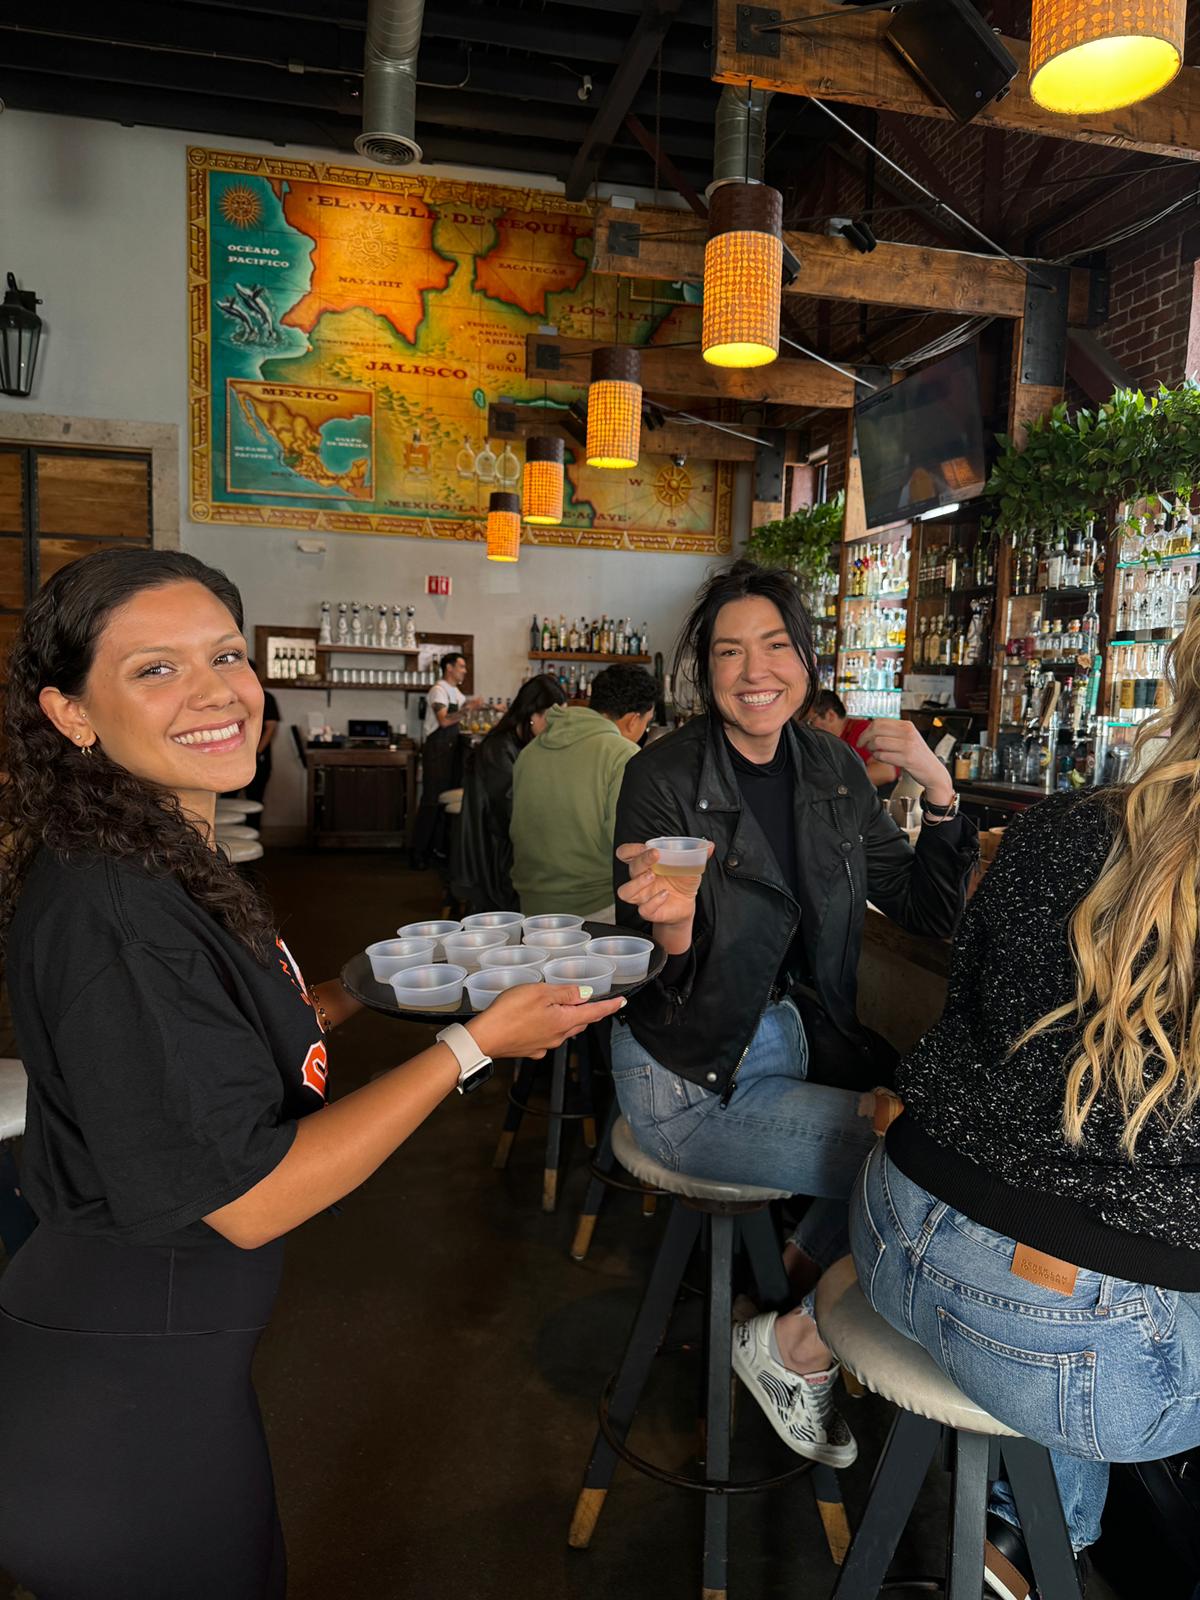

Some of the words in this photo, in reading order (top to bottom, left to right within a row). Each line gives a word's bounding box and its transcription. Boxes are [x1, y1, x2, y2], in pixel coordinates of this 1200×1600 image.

[317, 195, 349, 209] EL
[357, 200, 440, 221] VALLE
[451, 212, 486, 226] DE
[338, 275, 403, 289] NAYARIT
[485, 338, 523, 347] ARENA
[365, 360, 468, 380] JALISCO
[261, 386, 339, 402] MEXICO
[628, 478, 644, 488] W
[388, 499, 450, 511] MEXICO
